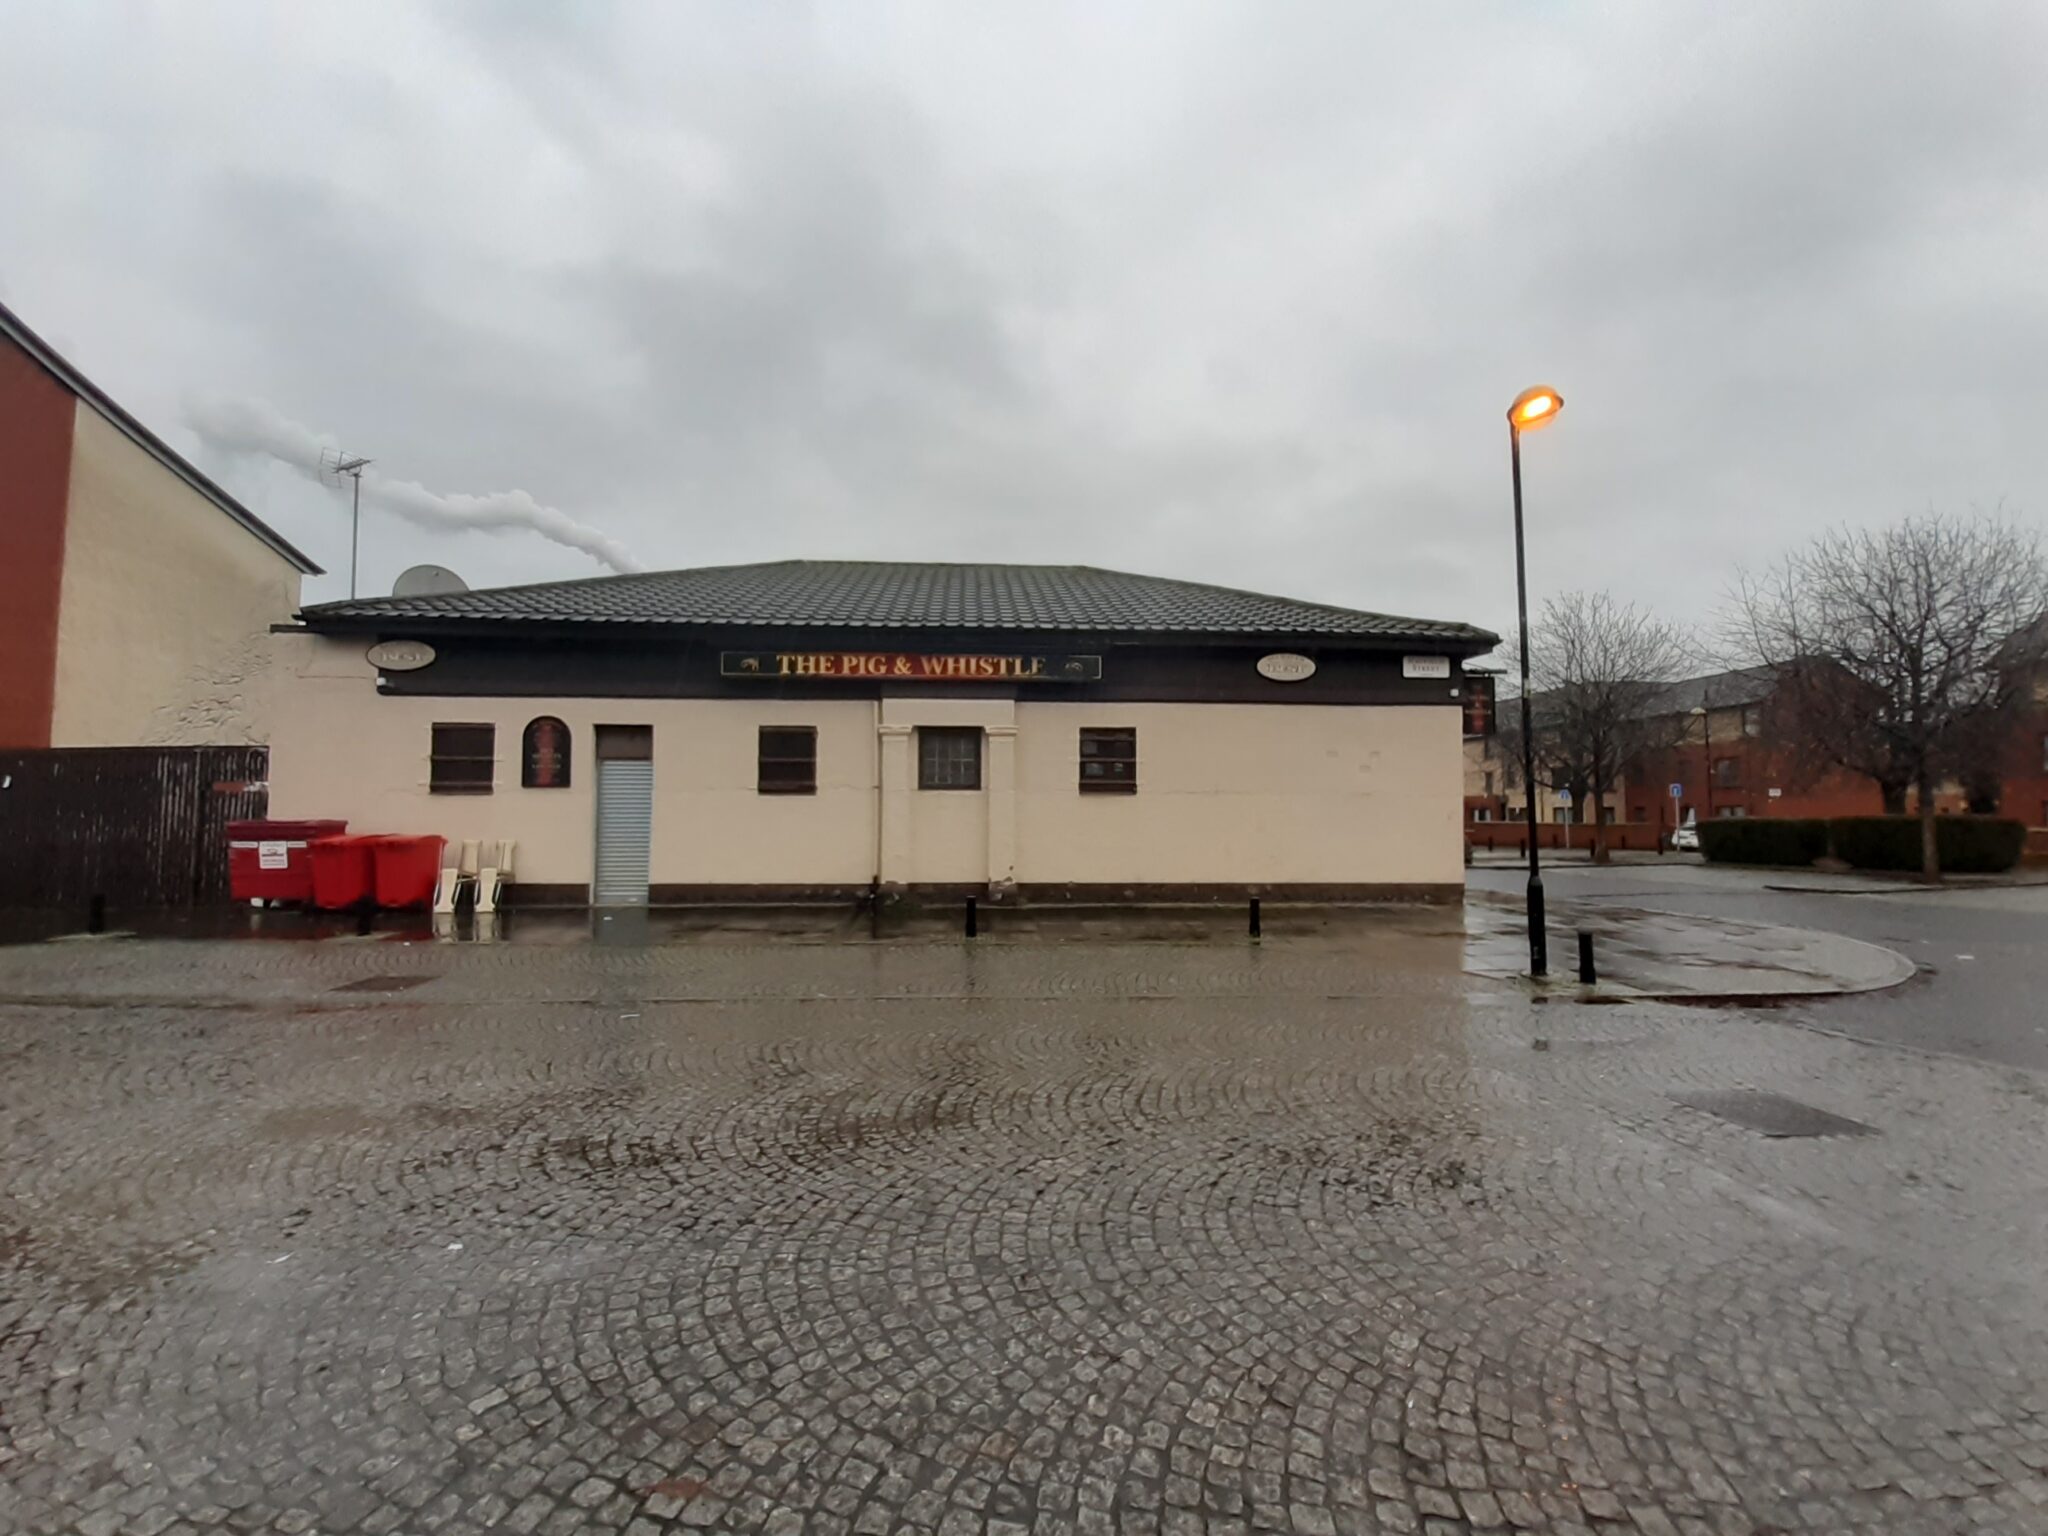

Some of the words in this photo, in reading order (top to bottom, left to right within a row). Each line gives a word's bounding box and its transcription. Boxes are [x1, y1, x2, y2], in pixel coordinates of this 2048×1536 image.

[776, 655, 835, 676] THE
[841, 655, 888, 676] PIG
[893, 656, 913, 676] &
[920, 656, 1046, 677] WHISTLE
